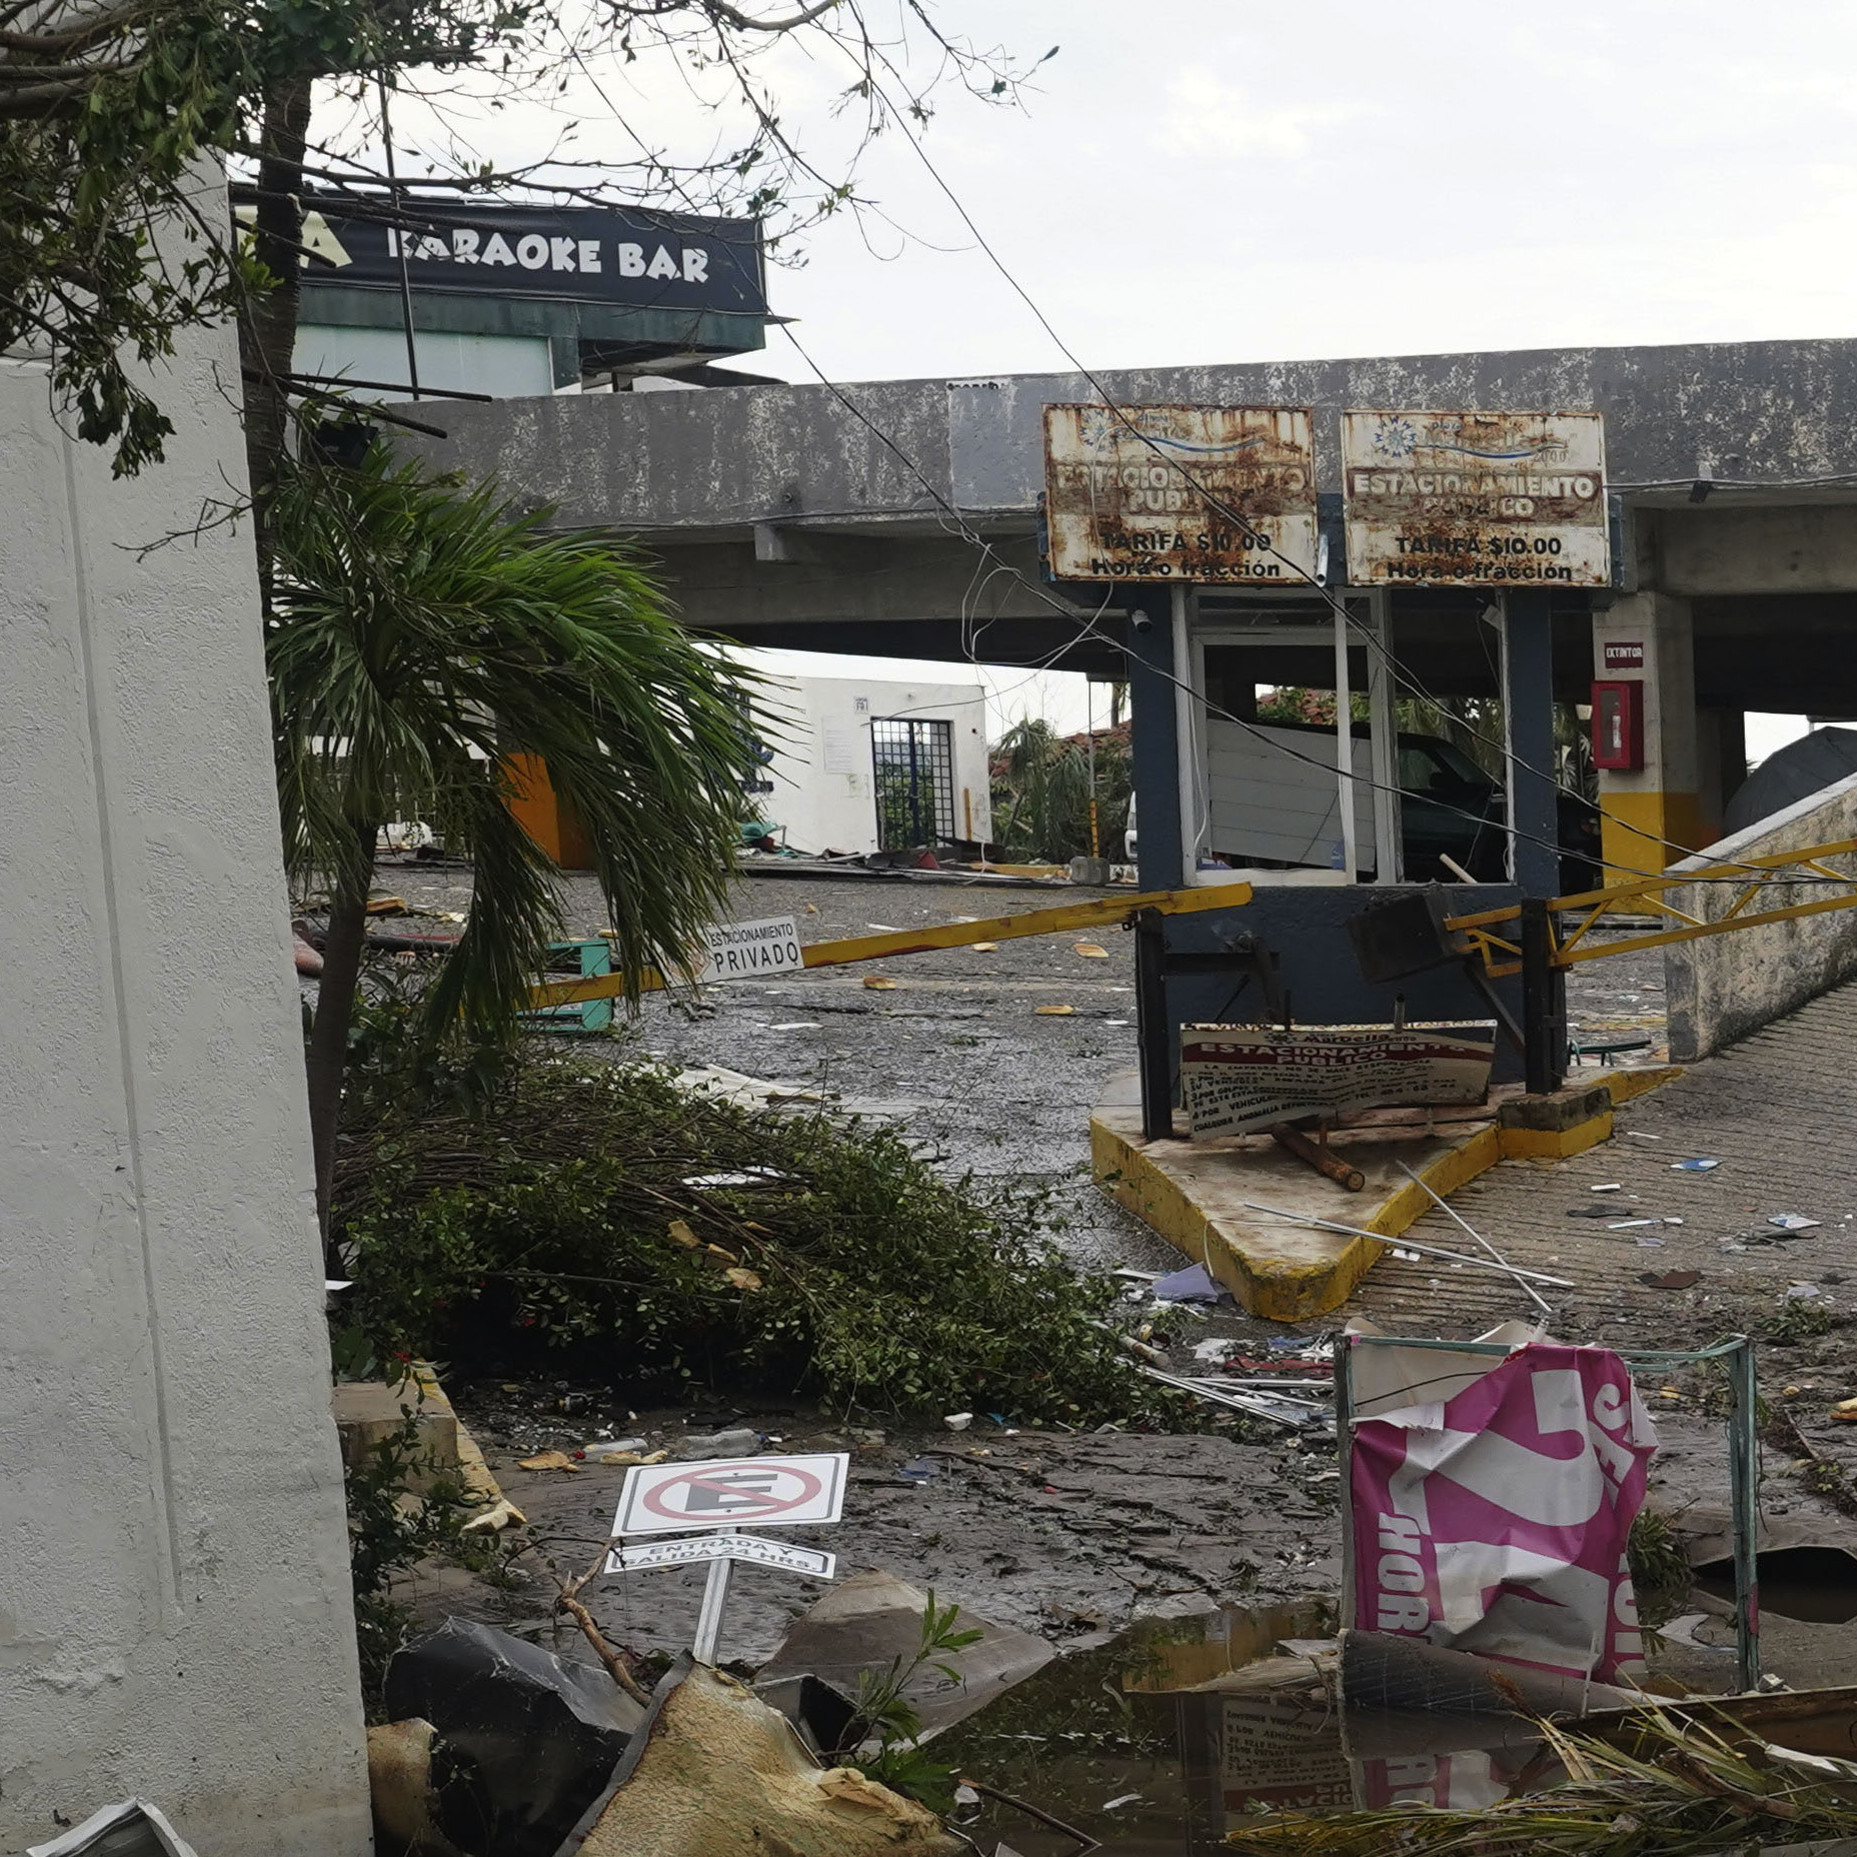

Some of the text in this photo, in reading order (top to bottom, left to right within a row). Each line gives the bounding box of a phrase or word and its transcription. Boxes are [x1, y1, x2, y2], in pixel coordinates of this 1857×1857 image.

[387, 225, 602, 273] KARAOKE
[618, 242, 710, 284] BAR
[1395, 537, 1562, 556] TARIFA $10.00
[1388, 561, 1444, 579] Hora
[1606, 646, 1643, 659] EXTINTOR
[711, 922, 793, 947] ESTACIONAMIENTO
[713, 941, 799, 974] PRIVADO
[1276, 1051, 1387, 1066] PUBLICO
[649, 1535, 794, 1557] ENTRADA Y
[720, 1547, 751, 1556] 24
[759, 1551, 818, 1571] HRS.
